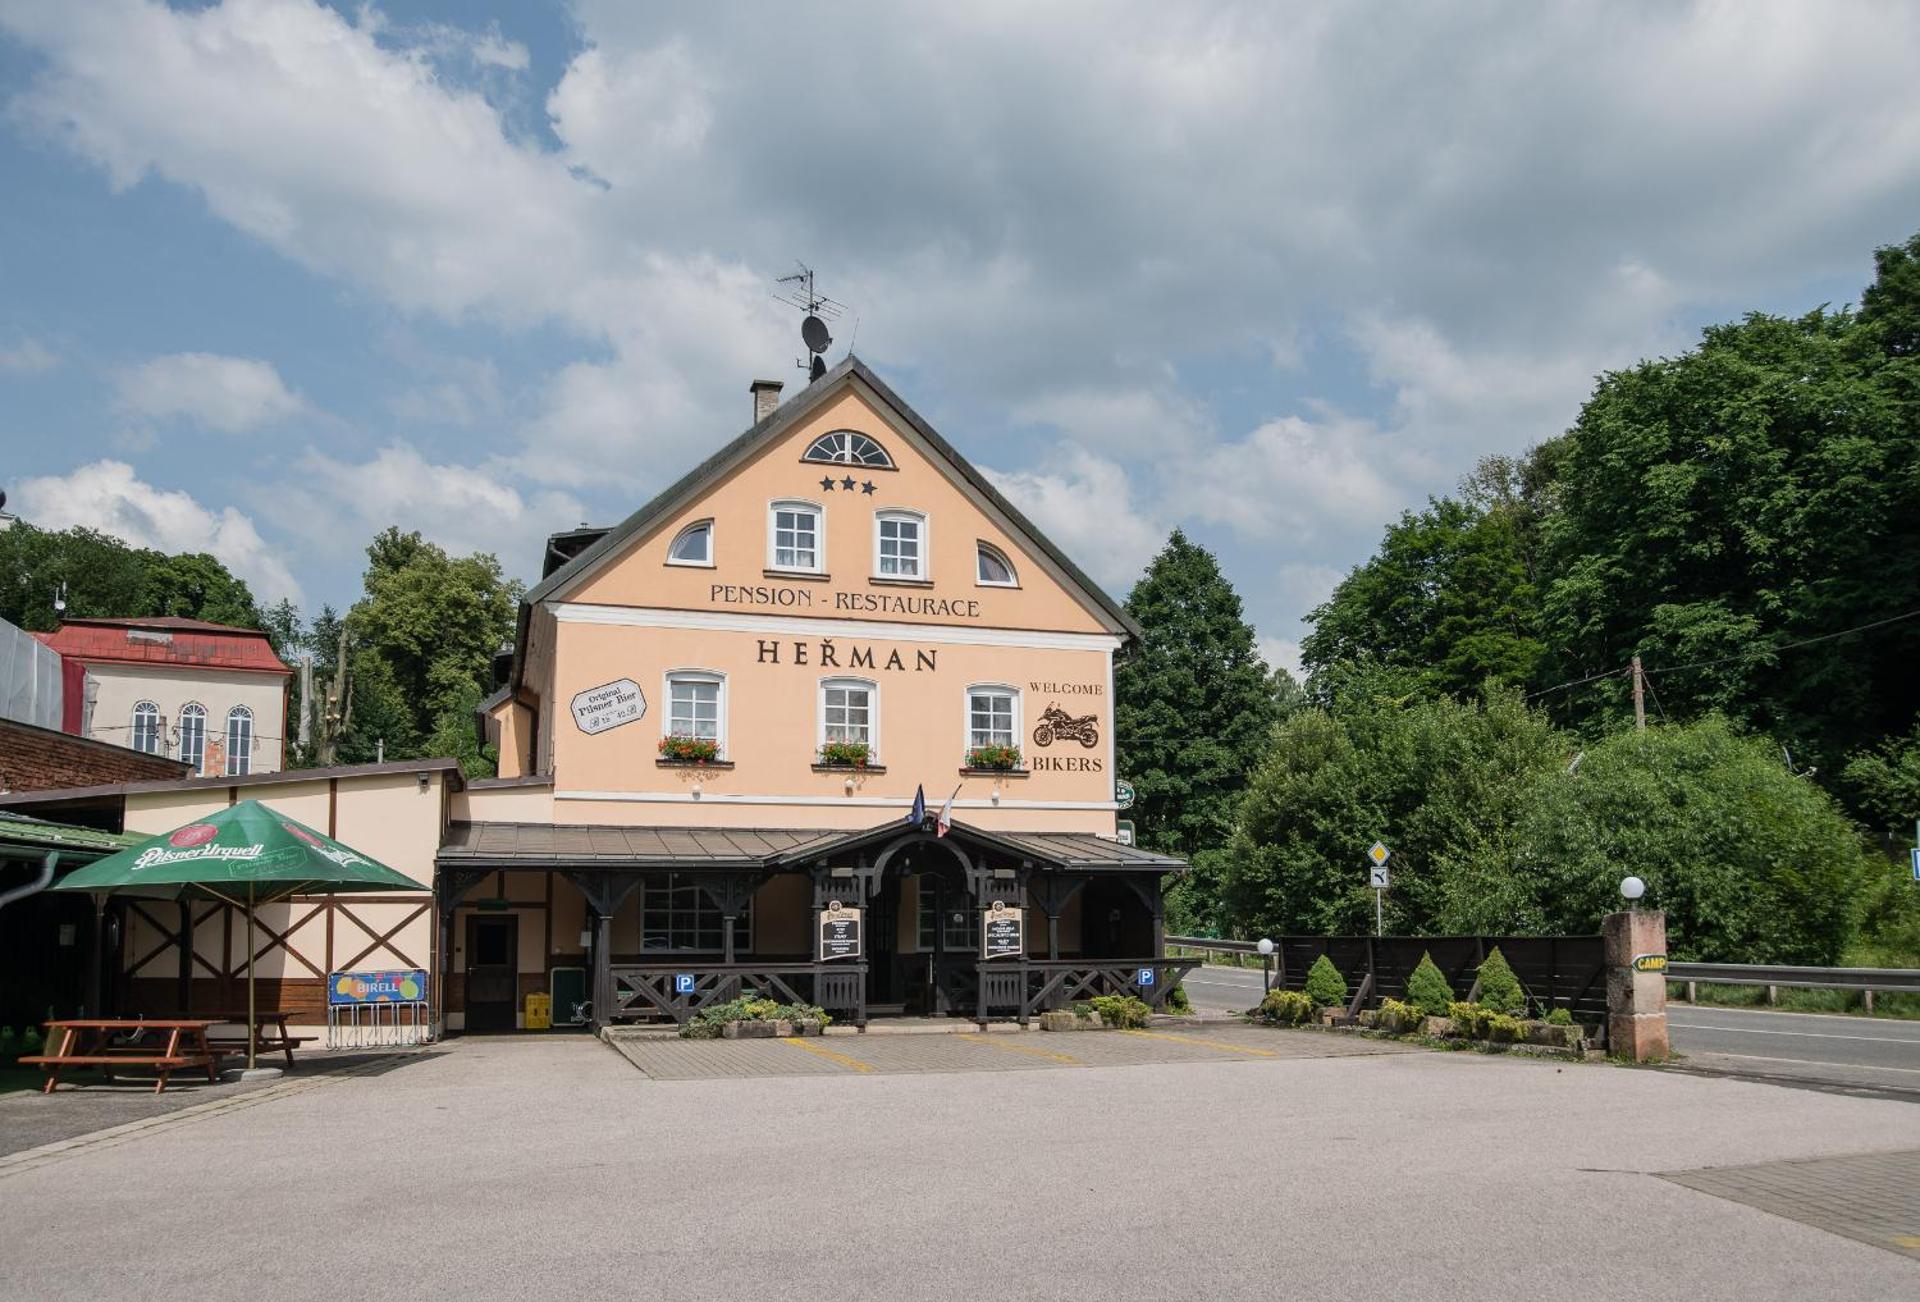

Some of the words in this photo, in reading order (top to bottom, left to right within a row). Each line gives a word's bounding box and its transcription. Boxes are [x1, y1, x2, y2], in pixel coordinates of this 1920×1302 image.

[711, 584, 811, 606] PENSION
[836, 592, 980, 618] RESTAURACE
[757, 639, 938, 671] HEŘMAN
[588, 688, 621, 703] Original
[1030, 682, 1103, 695] WELCOME
[578, 700, 612, 716] Pilsner
[616, 692, 636, 704] Bier
[1033, 757, 1103, 773] BIKERS
[1638, 957, 1666, 969] CAMP
[681, 977, 691, 990] P
[1142, 971, 1151, 982] P
[357, 982, 399, 993] BIRELL
